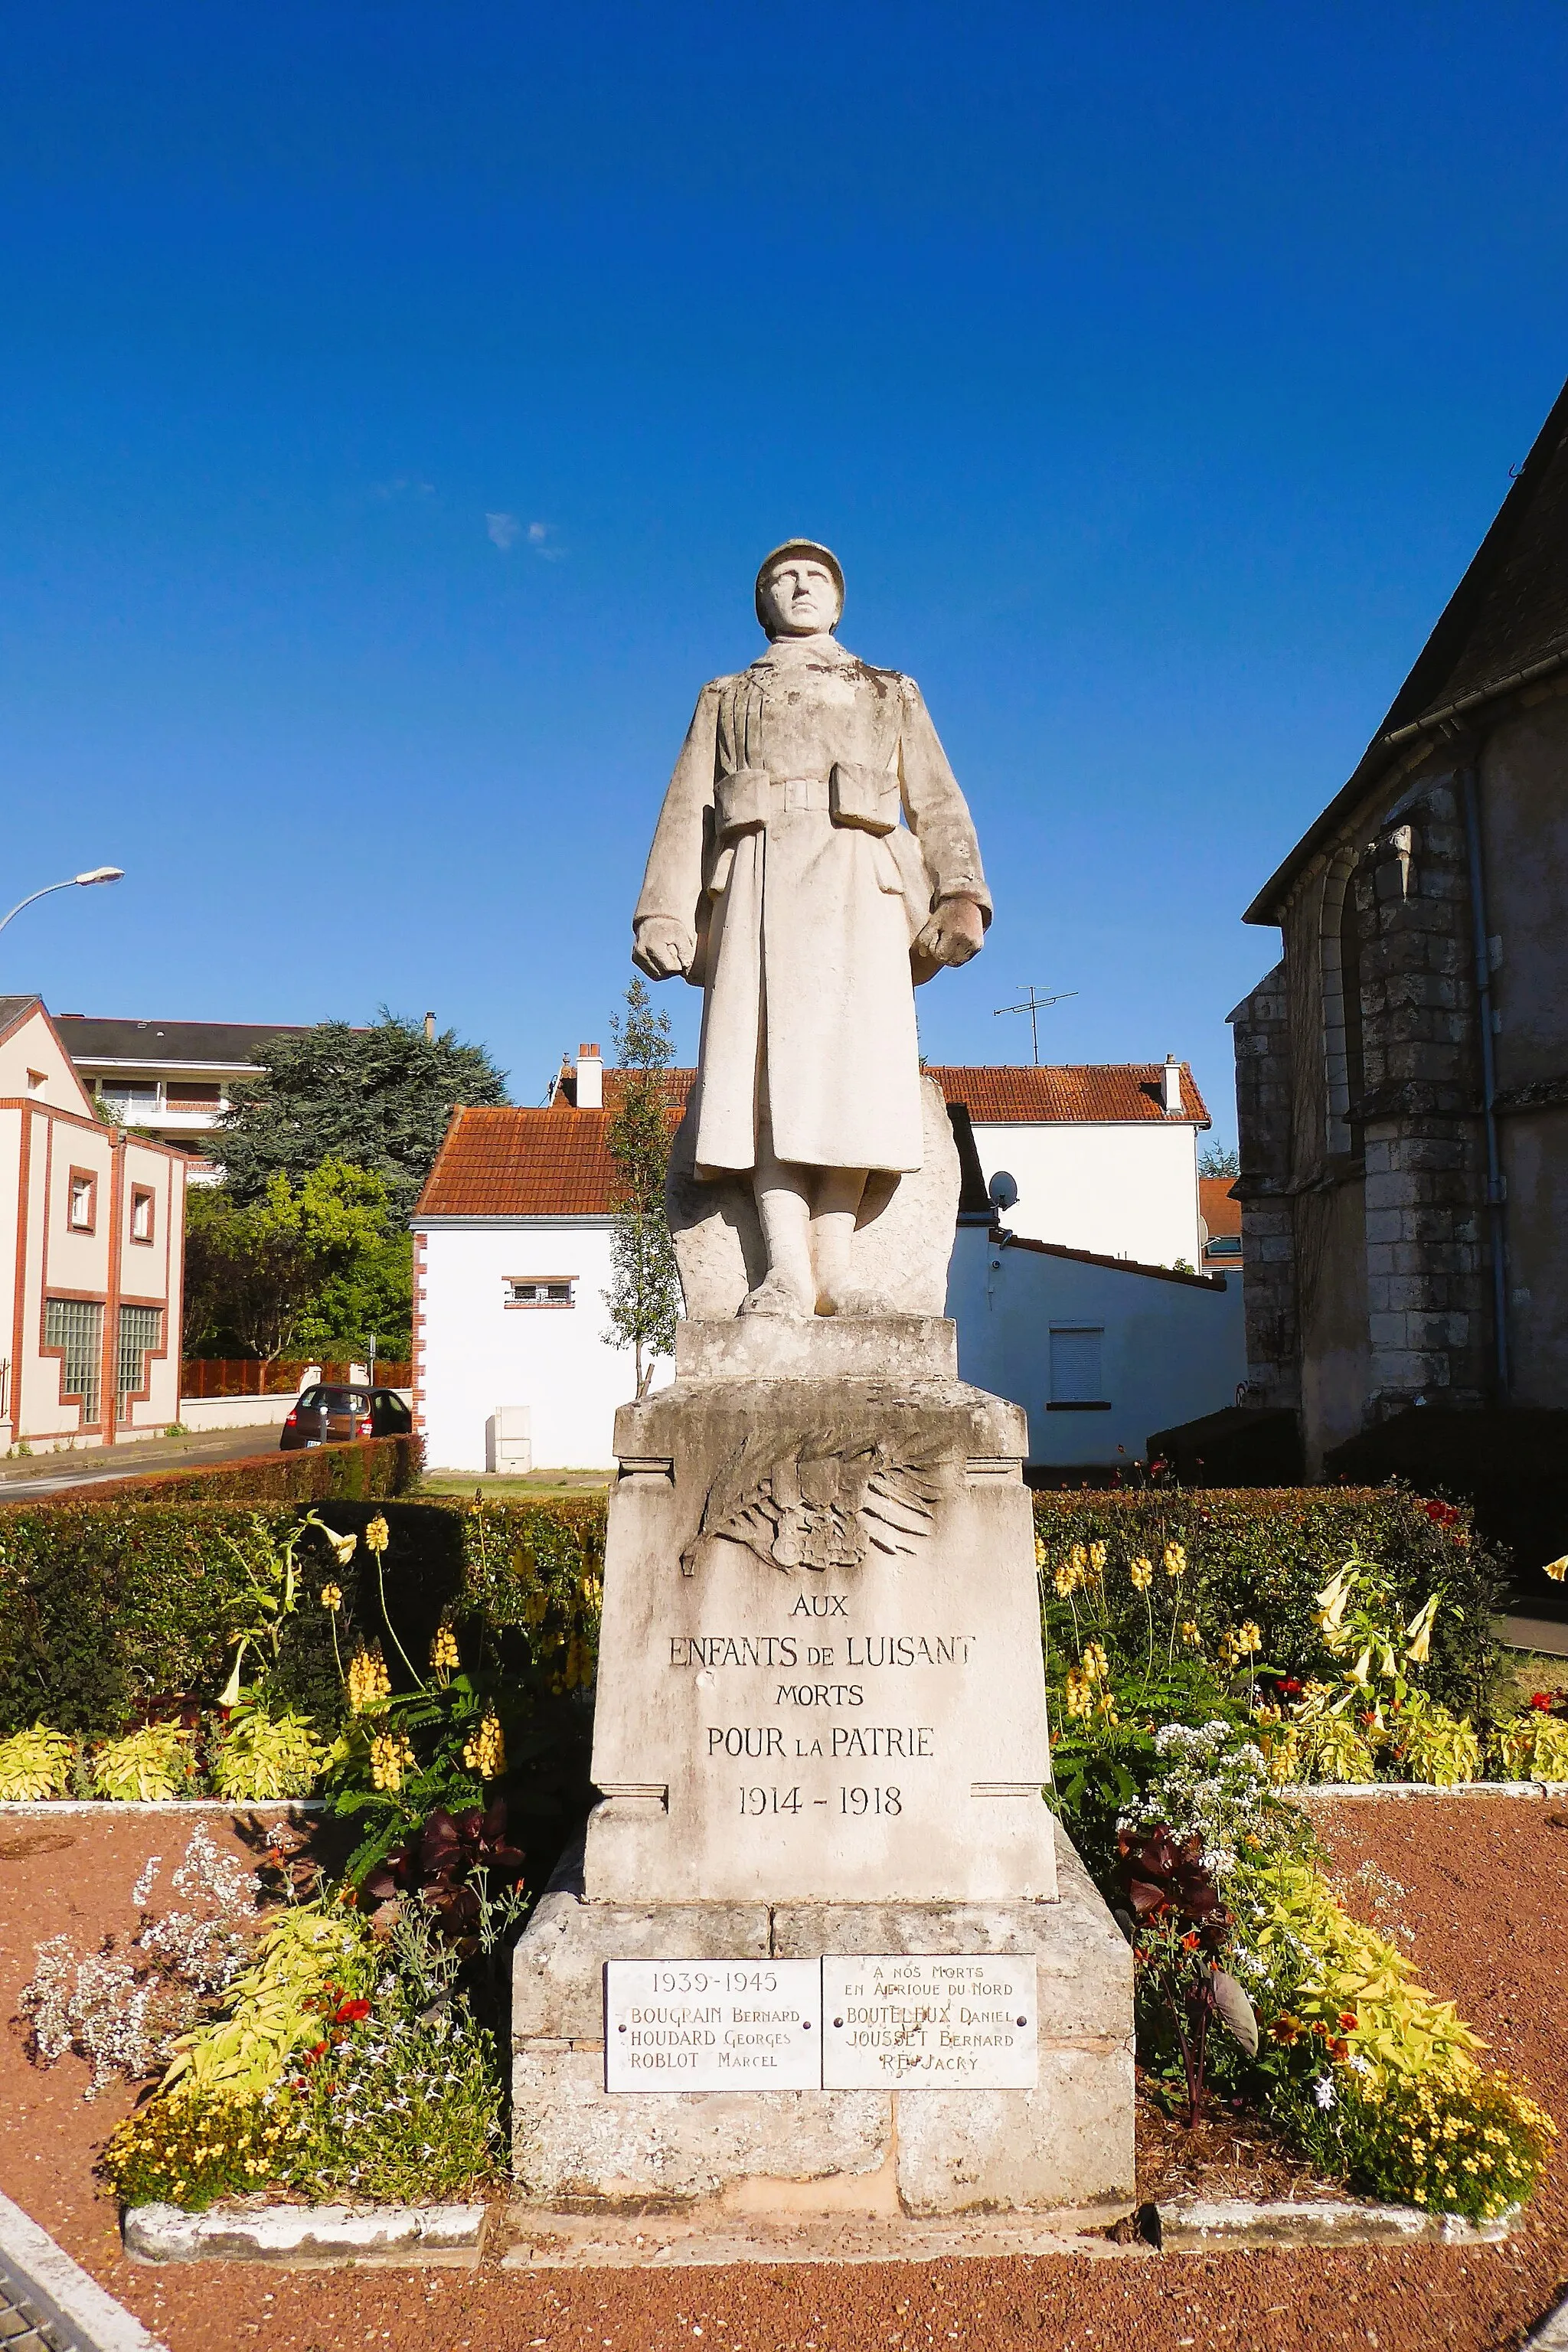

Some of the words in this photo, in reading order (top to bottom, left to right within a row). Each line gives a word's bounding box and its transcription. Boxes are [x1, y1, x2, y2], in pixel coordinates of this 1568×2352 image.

[790, 1593, 848, 1617] AUX
[669, 1635, 798, 1667] ENFANTS
[807, 1645, 835, 1666] DE
[847, 1635, 977, 1665] LUISANT
[774, 1684, 864, 1707] MORTS
[707, 1726, 787, 1758] POUR
[795, 1738, 824, 1757] LA
[830, 1727, 936, 1758] PATRIE
[739, 1786, 803, 1815] 1914
[840, 1786, 903, 1815] 1918
[893, 1967, 921, 1978] NOS
[932, 1966, 984, 1978] MORTS
[844, 1984, 864, 1996] EN
[949, 1984, 965, 1996] DU
[972, 1981, 1013, 1996] NORD
[631, 2007, 722, 2027] BOUGRAIN
[732, 2007, 800, 2024] BERNARD
[847, 2007, 951, 2024] BOUTELEUX
[960, 2007, 1014, 2024] DANIEL
[631, 2030, 716, 2047] HOUDARD
[724, 2030, 792, 2048] GEORGES
[845, 2030, 929, 2047] JOUSSET
[940, 2030, 1014, 2047] BERNARD
[631, 2052, 699, 2069] ROBLOT
[718, 2052, 778, 2068] MARCEL
[920, 2053, 978, 2070] JACKY
